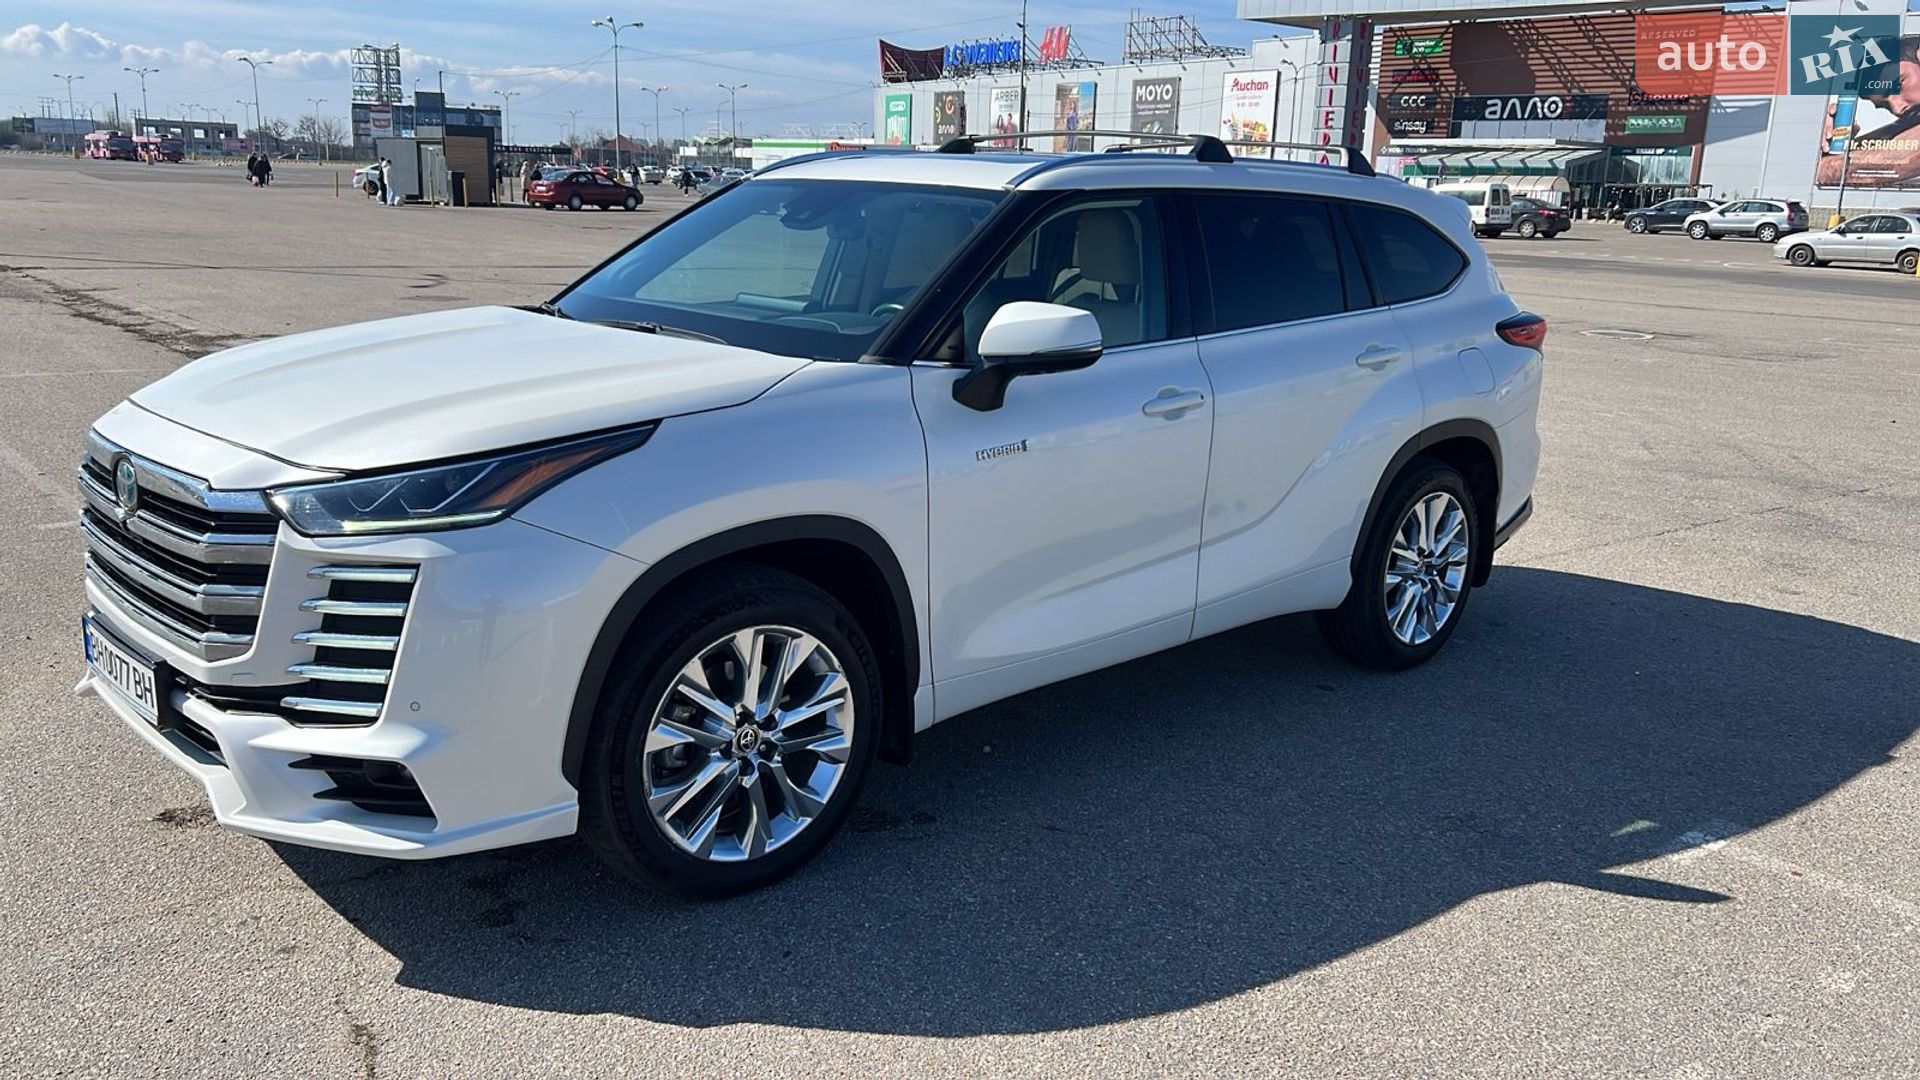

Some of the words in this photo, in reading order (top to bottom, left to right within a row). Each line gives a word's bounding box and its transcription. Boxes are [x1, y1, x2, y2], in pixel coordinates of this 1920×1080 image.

[1641, 29, 1696, 40] RESERVED
[1231, 78, 1269, 92] Auchan
[995, 90, 1019, 102] ARBER
[1136, 83, 1173, 102] MOYO
[1400, 95, 1427, 107] CCC
[975, 442, 1022, 462] HYBRID
